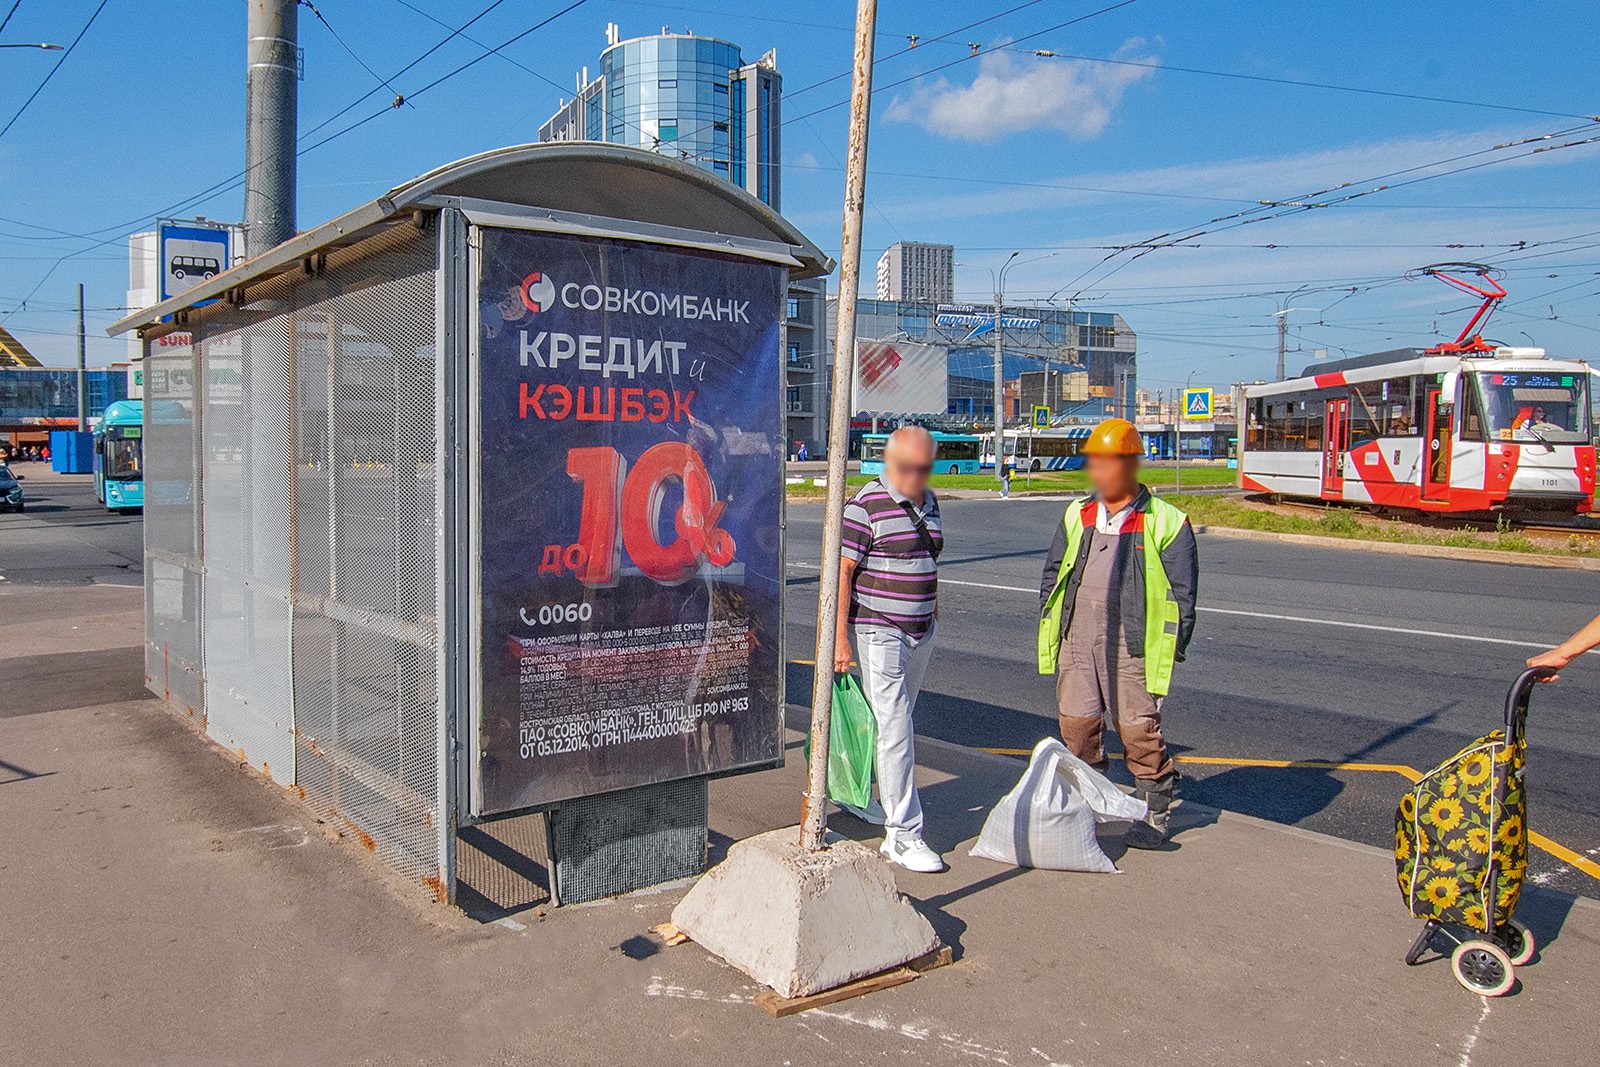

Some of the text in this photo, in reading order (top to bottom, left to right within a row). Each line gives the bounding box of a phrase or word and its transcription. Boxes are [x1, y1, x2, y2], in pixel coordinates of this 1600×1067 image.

[561, 282, 750, 324] СОВКОМБАНК
[518, 330, 687, 378] КРЕДИТ
[1502, 374, 1518, 386] 25
[518, 381, 696, 422] КЭШБЭК
[538, 602, 592, 626] 0060
[579, 632, 599, 641] КАРТЫ
[601, 629, 625, 639] «ХАЛВА»
[634, 626, 660, 636] ПЕРЕВОДЕ
[683, 622, 704, 631] СУММЫ
[520, 653, 556, 665] СТОИМОСТЬ
[592, 647, 616, 658] МОМЕНТ
[655, 641, 683, 651] ДОГОВОРА
[739, 642, 748, 650] 000
[520, 673, 544, 684] БАЛЛОВ
[520, 697, 748, 744] ПАО «СОВКОМБАНК». ГЕН. ЛИЦ. ЦБ РФ № 963
[520, 742, 534, 759] ОТ
[538, 734, 590, 756] 05.12.2014,
[592, 729, 620, 748] ОГРН
